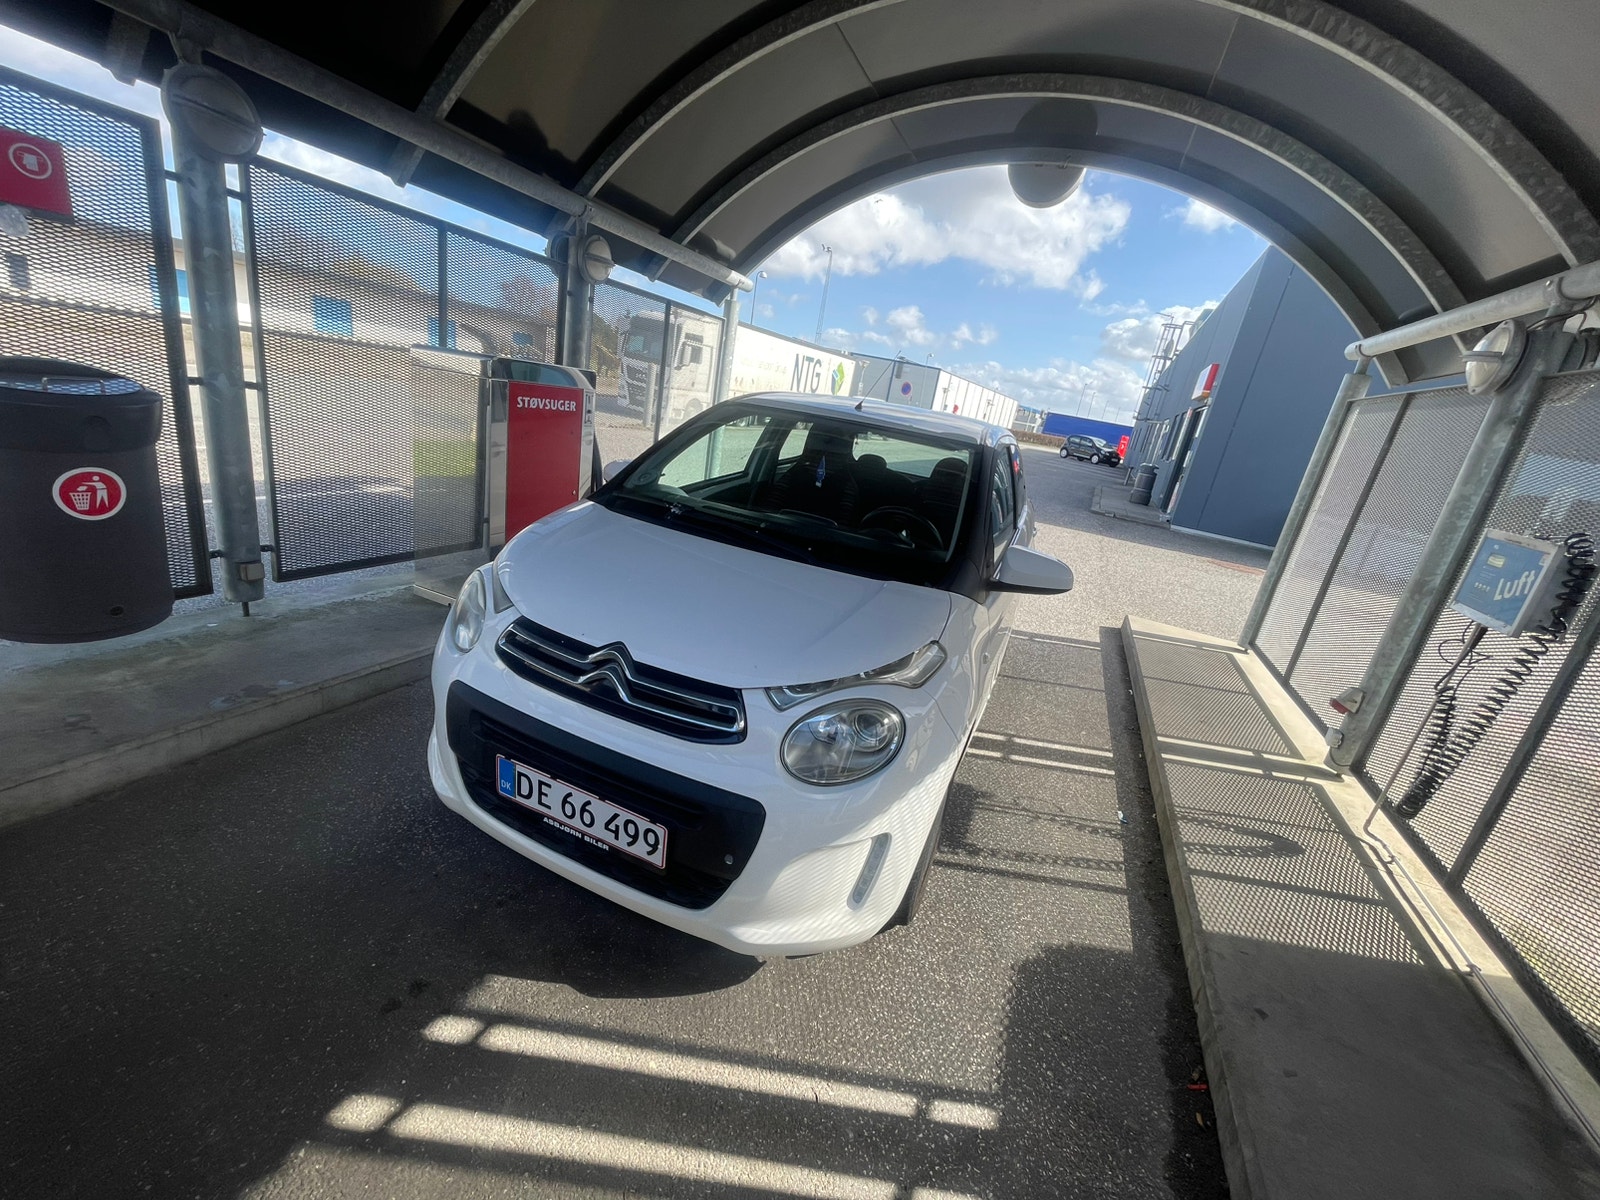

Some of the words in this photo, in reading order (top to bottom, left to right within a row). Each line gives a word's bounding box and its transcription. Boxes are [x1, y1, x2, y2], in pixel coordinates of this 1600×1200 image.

[790, 353, 822, 393] NTG
[516, 396, 577, 412] STØVSUGER
[1493, 570, 1535, 601] Luft
[501, 779, 512, 791] DK
[517, 771, 552, 810] DE
[561, 791, 596, 829] 66
[604, 812, 660, 856] 499
[584, 835, 609, 851] BILER
